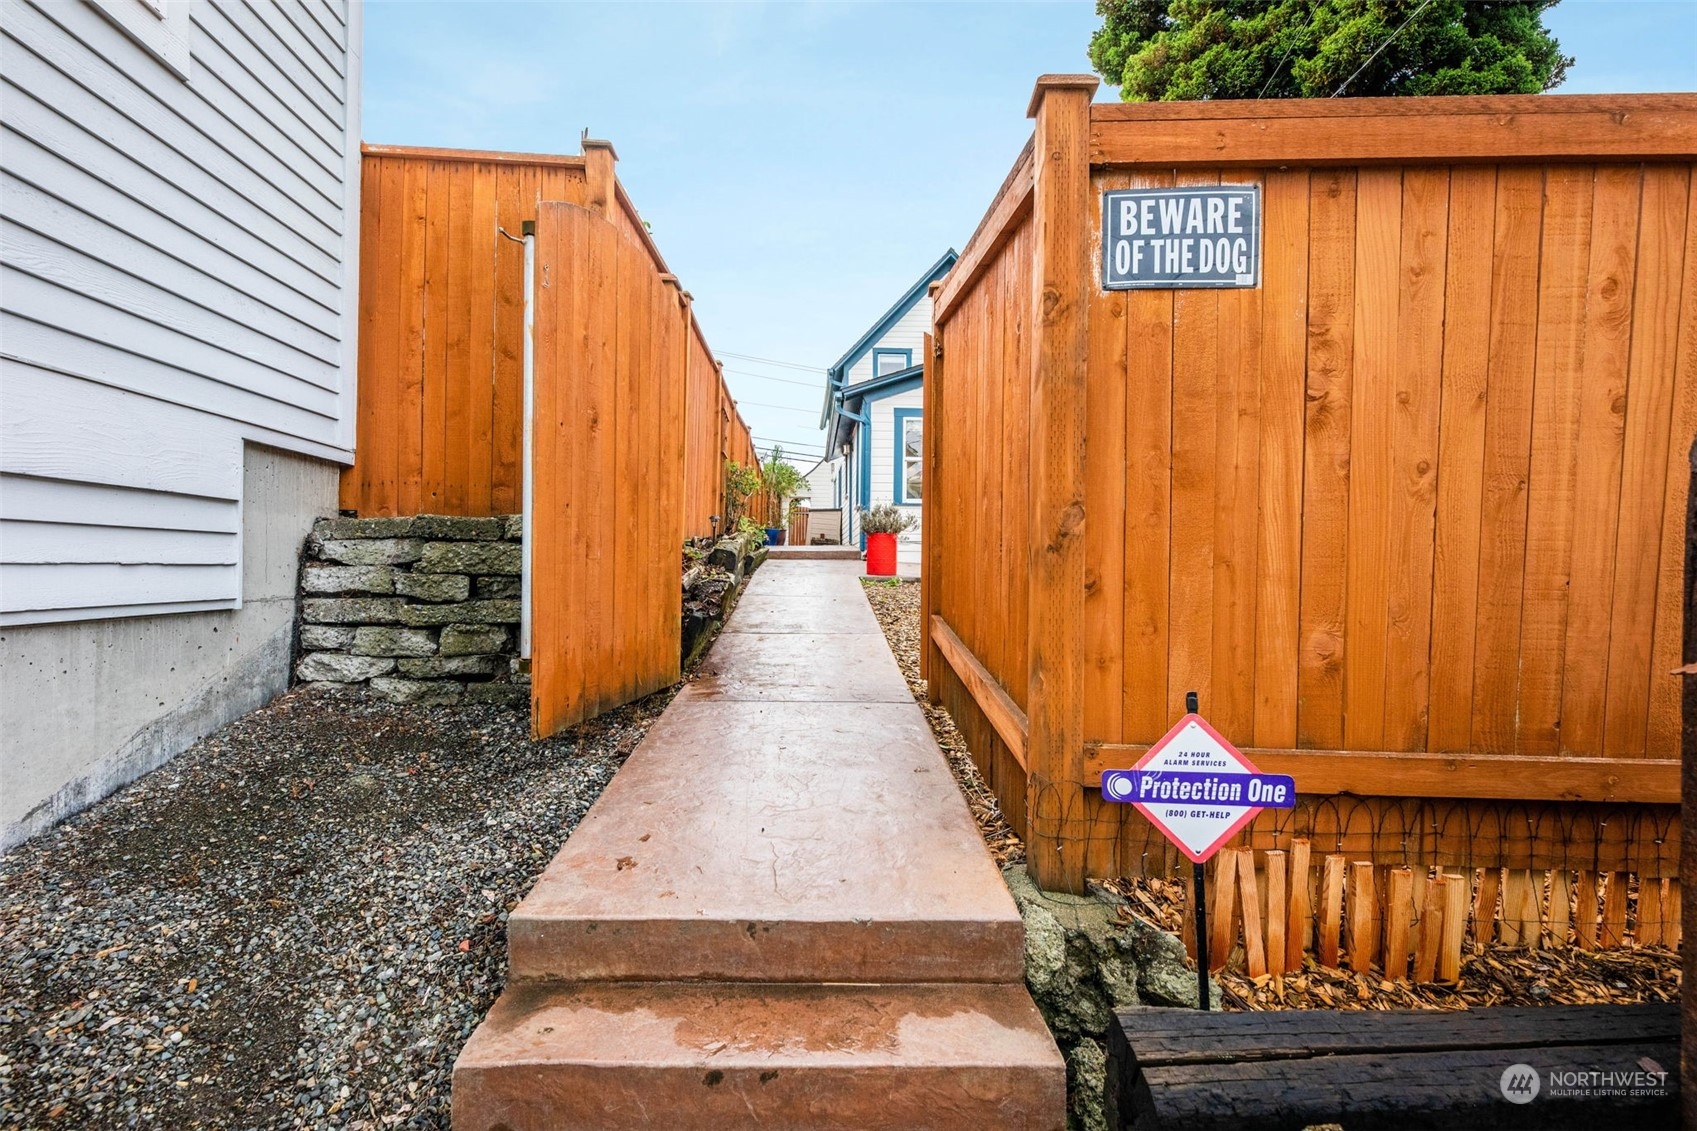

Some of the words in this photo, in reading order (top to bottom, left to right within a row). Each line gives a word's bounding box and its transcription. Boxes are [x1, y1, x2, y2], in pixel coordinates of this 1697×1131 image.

[1120, 197, 1243, 236] BEWARE
[1115, 239, 1145, 275] OF
[1150, 238, 1194, 274] THE
[1199, 237, 1247, 274] DOG
[1139, 775, 1242, 801] Protection
[1247, 778, 1287, 803] One
[1165, 809, 1187, 819] (800)
[1190, 810, 1231, 819] GET-HELP
